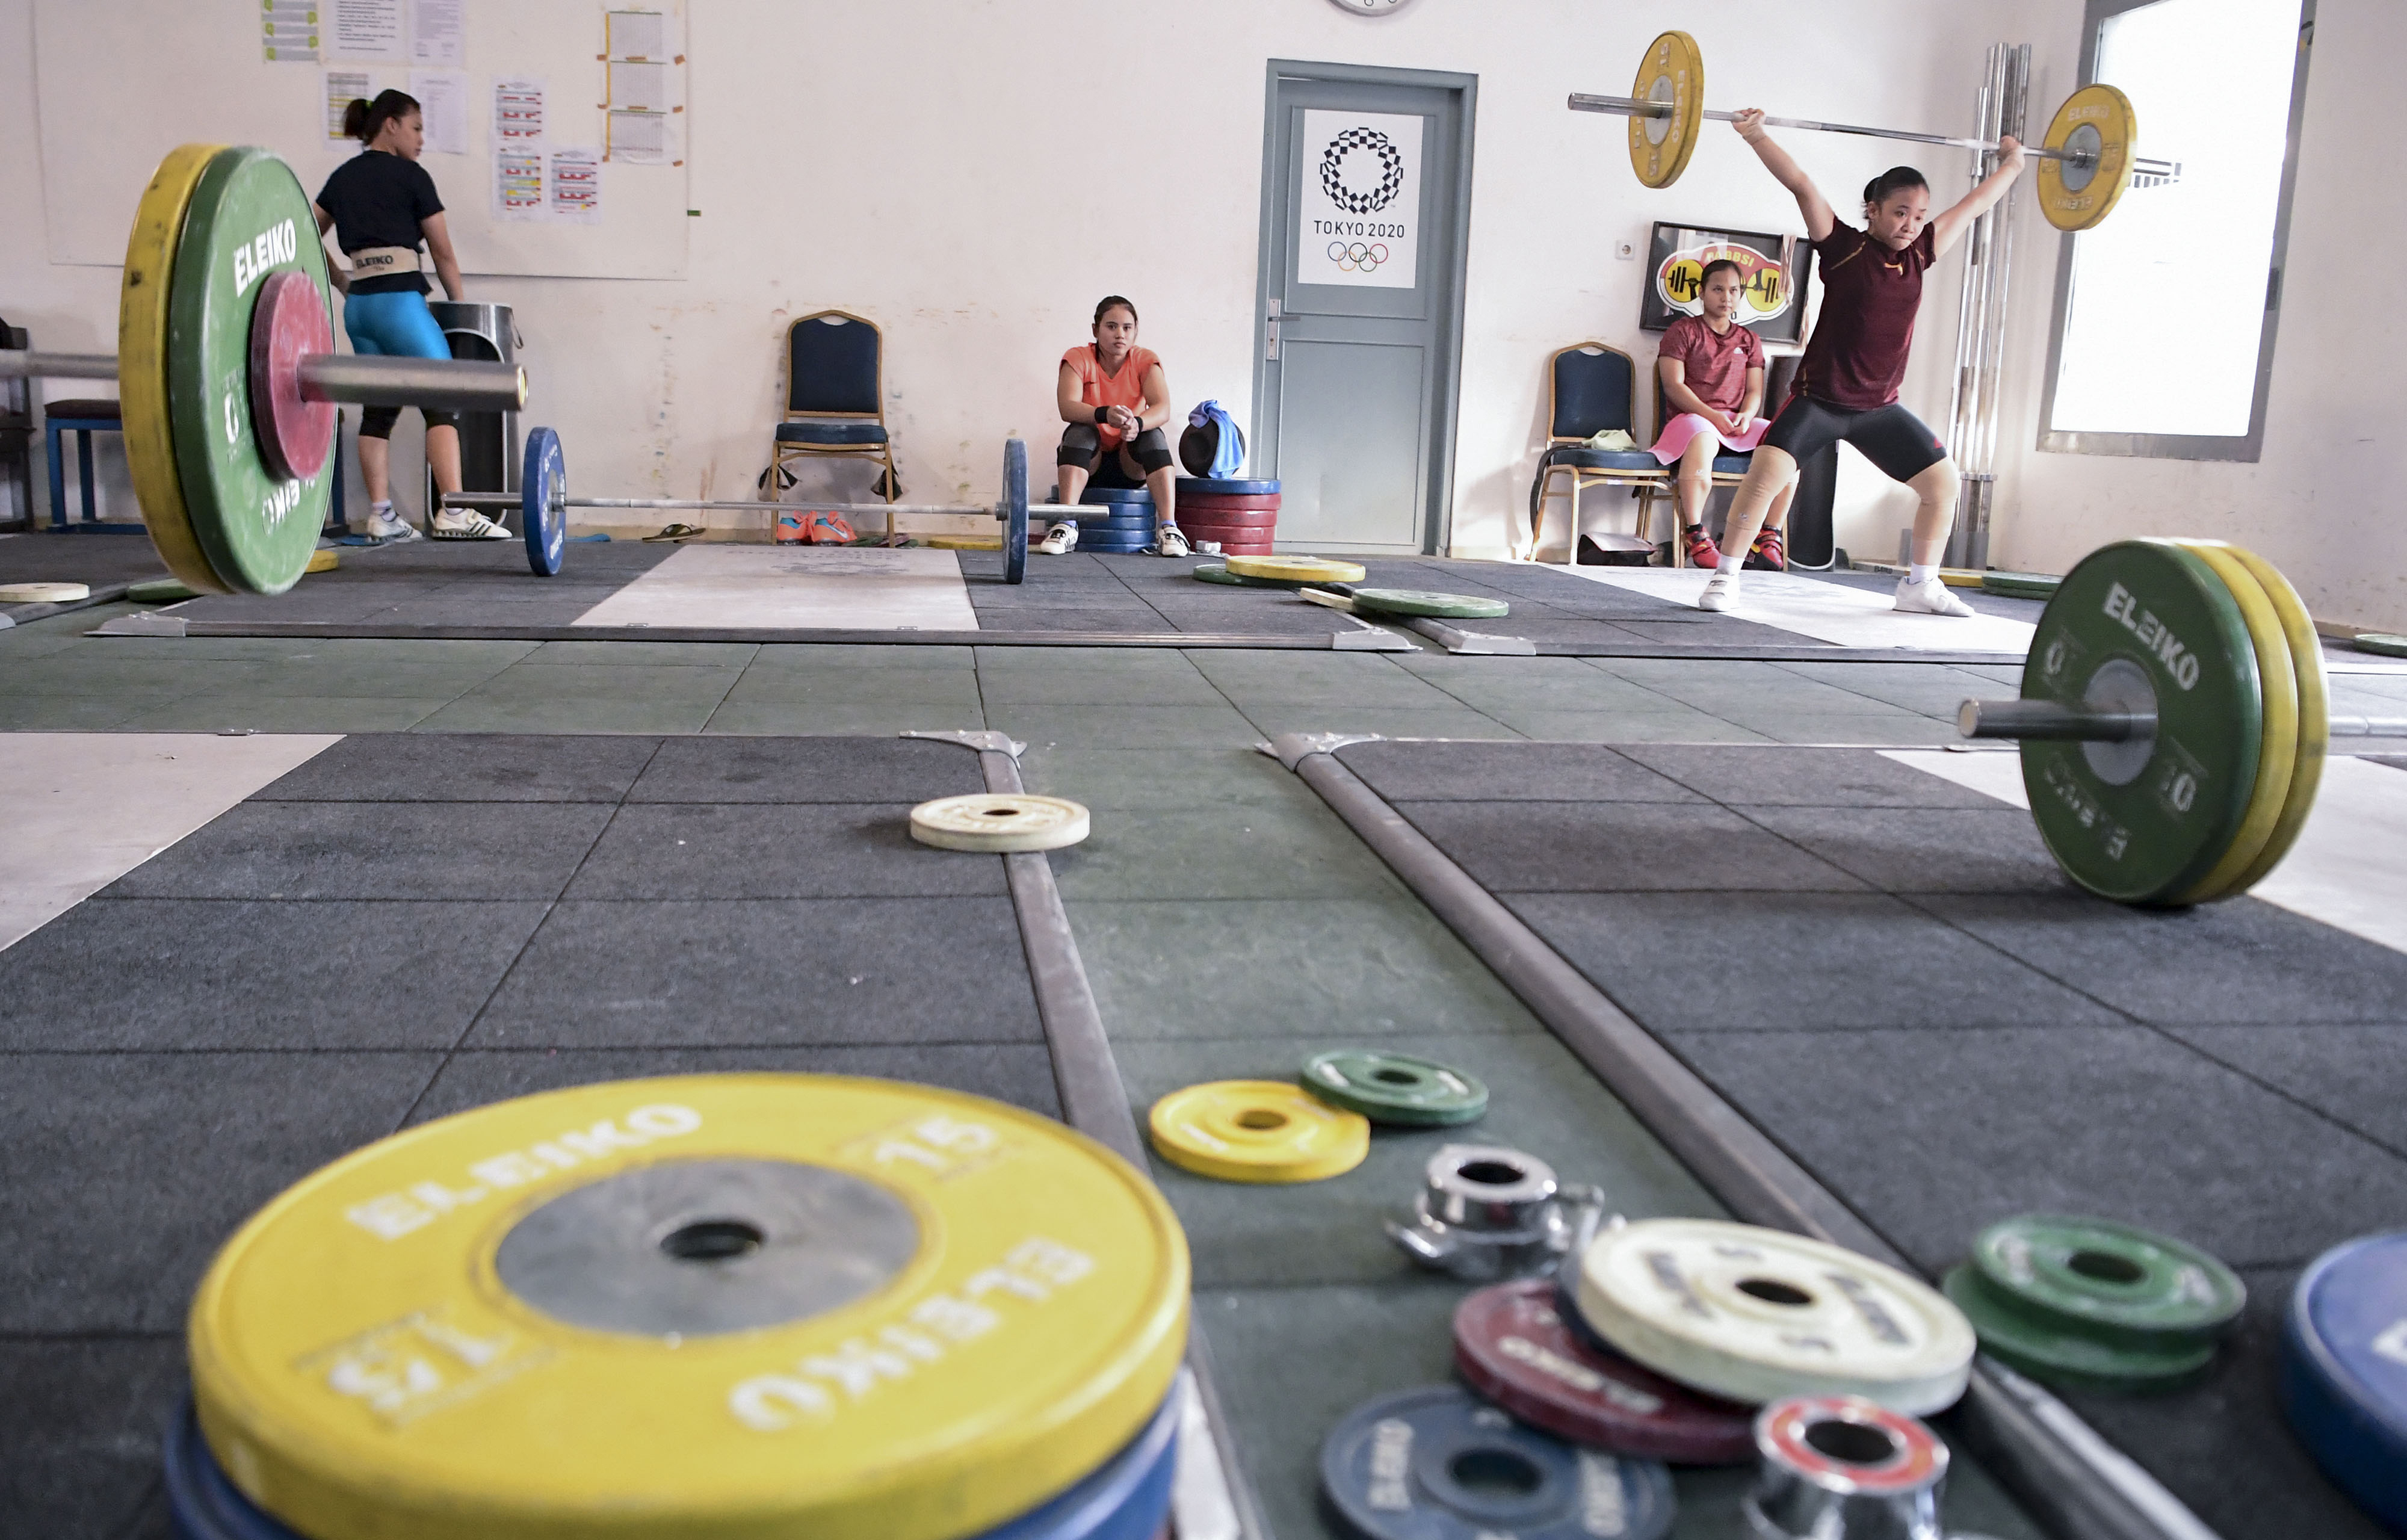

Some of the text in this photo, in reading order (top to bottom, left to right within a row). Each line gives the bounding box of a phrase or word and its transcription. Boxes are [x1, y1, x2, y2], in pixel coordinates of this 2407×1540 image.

[234, 218, 296, 298] ELEIKO
[356, 255, 394, 269] ELEIKO
[1314, 220, 1405, 238] TOKYO 2020
[2103, 582, 2200, 691] ELEIKO
[345, 1104, 703, 1240] ELEIKO
[875, 1115, 998, 1167] 15
[326, 1315, 518, 1412] 15
[728, 1238, 1095, 1431] ELEIKO
